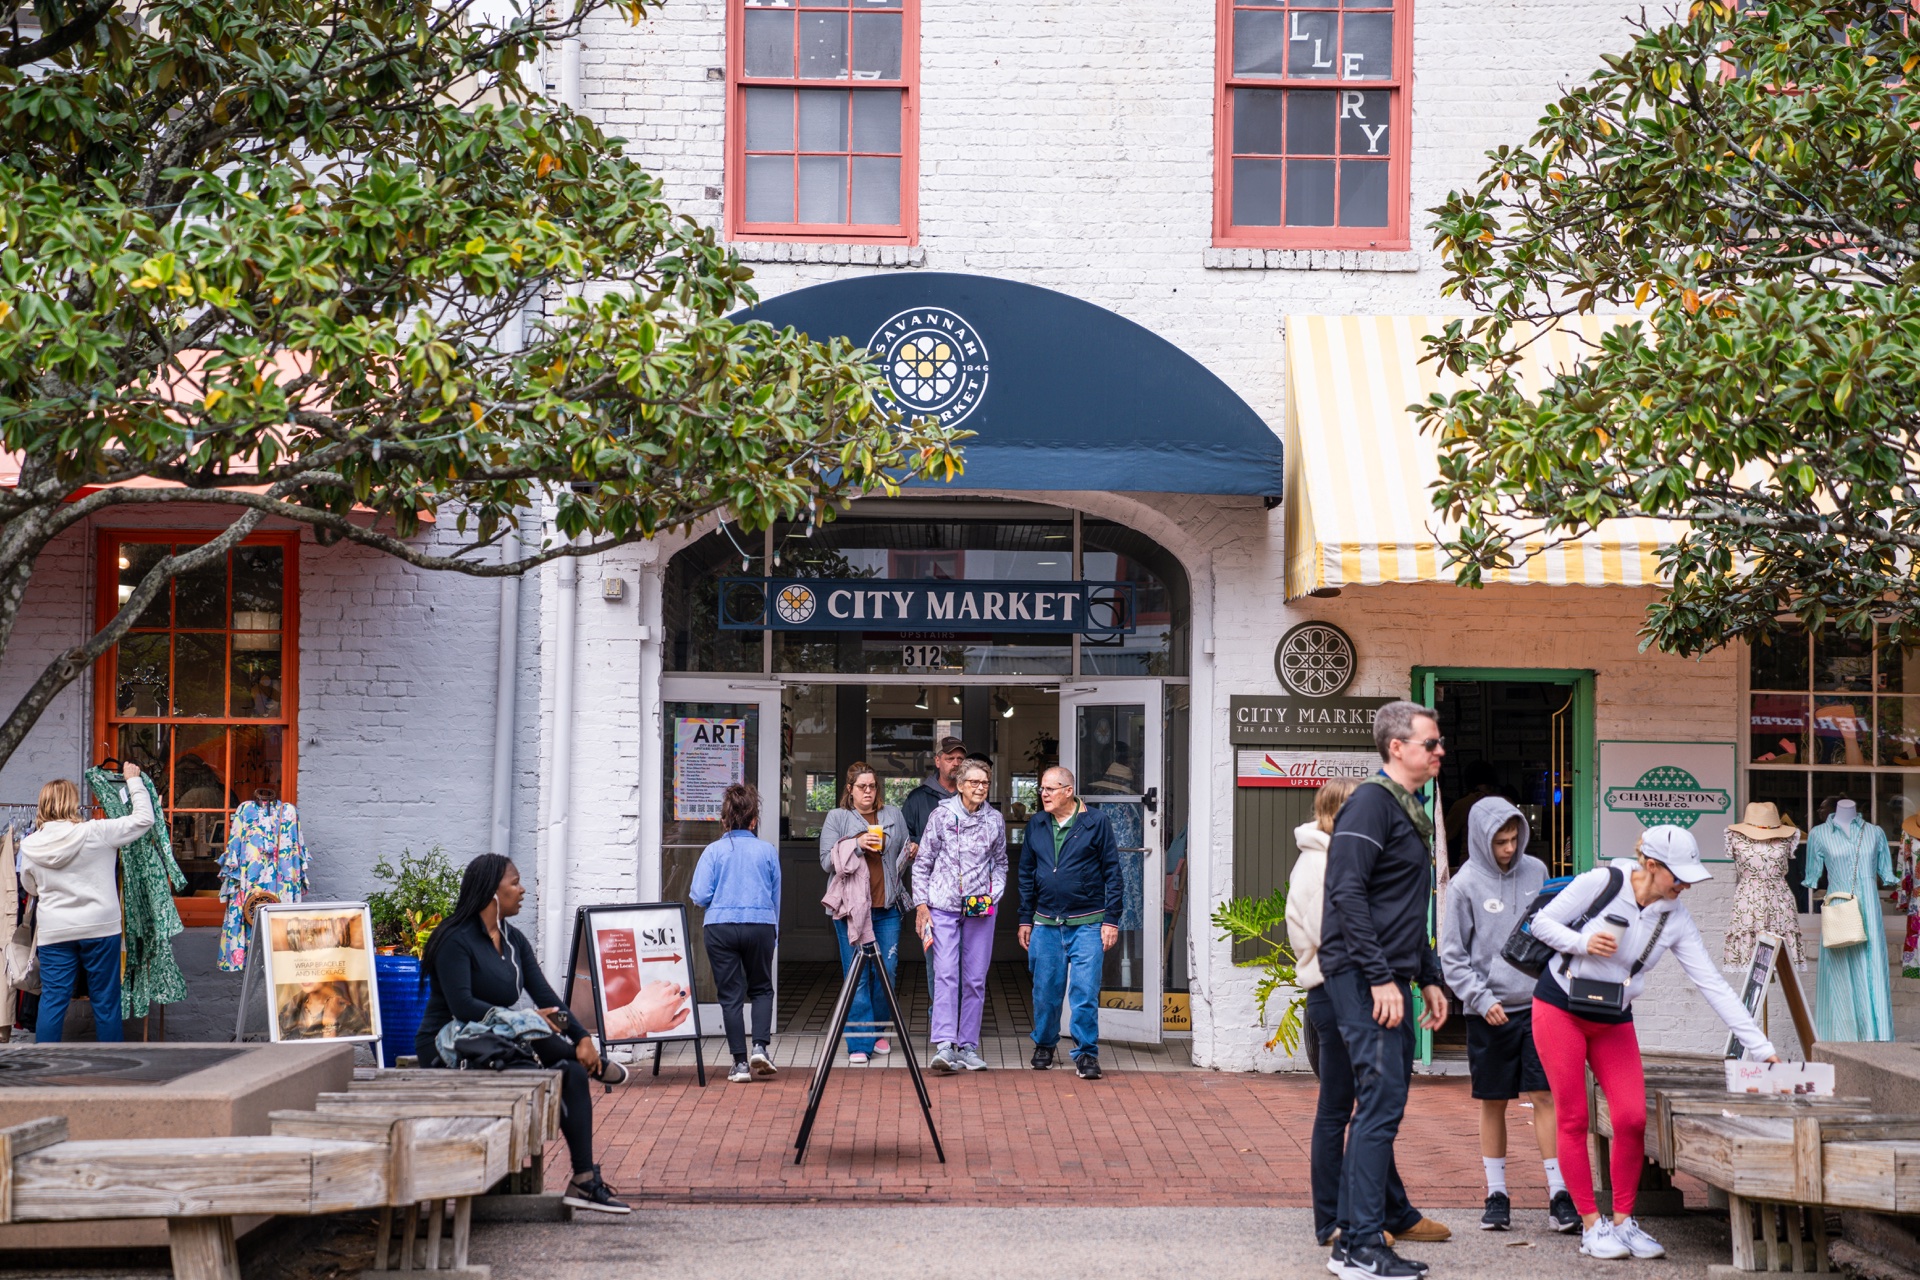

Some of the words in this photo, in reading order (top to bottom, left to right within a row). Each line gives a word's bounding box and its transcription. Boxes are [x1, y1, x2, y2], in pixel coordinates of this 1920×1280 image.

[875, 313, 978, 357] SAVANNAH
[962, 364, 989, 372] 1846
[911, 378, 979, 424] MRKET
[827, 590, 915, 620] CITY
[926, 591, 1080, 622] MARKET
[900, 631, 955, 639] UPSTAIRS
[904, 645, 940, 666] 312
[1236, 707, 1288, 723] CITY
[1298, 708, 1377, 724] MARKE
[693, 724, 740, 743] ART
[1342, 726, 1372, 734] SAVAN
[1289, 759, 1318, 777] art
[1317, 766, 1369, 777] CENTER
[1619, 792, 1715, 803] CHARLESTON
[295, 961, 315, 969] WRAP
[315, 960, 346, 968] BRACELET
[1163, 1014, 1188, 1024] udio
